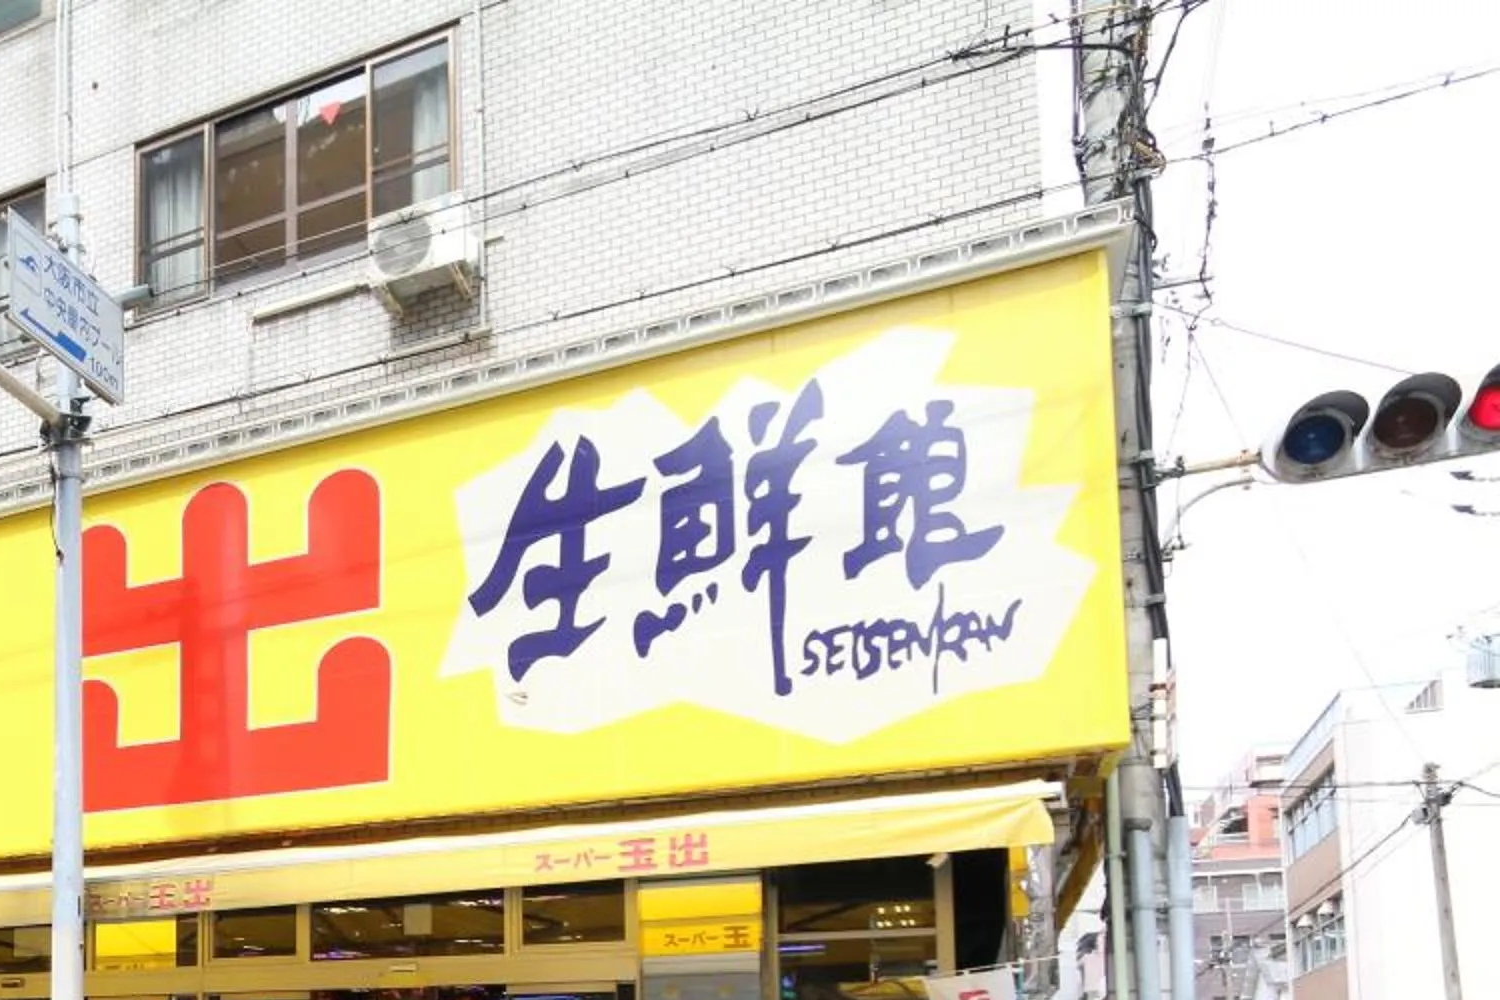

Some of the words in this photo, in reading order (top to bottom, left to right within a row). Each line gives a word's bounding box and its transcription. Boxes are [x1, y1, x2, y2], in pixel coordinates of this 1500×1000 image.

[43, 254, 99, 316] 大阪市立
[467, 378, 1005, 696] 生鮮館
[534, 833, 710, 872] スーパー玉出
